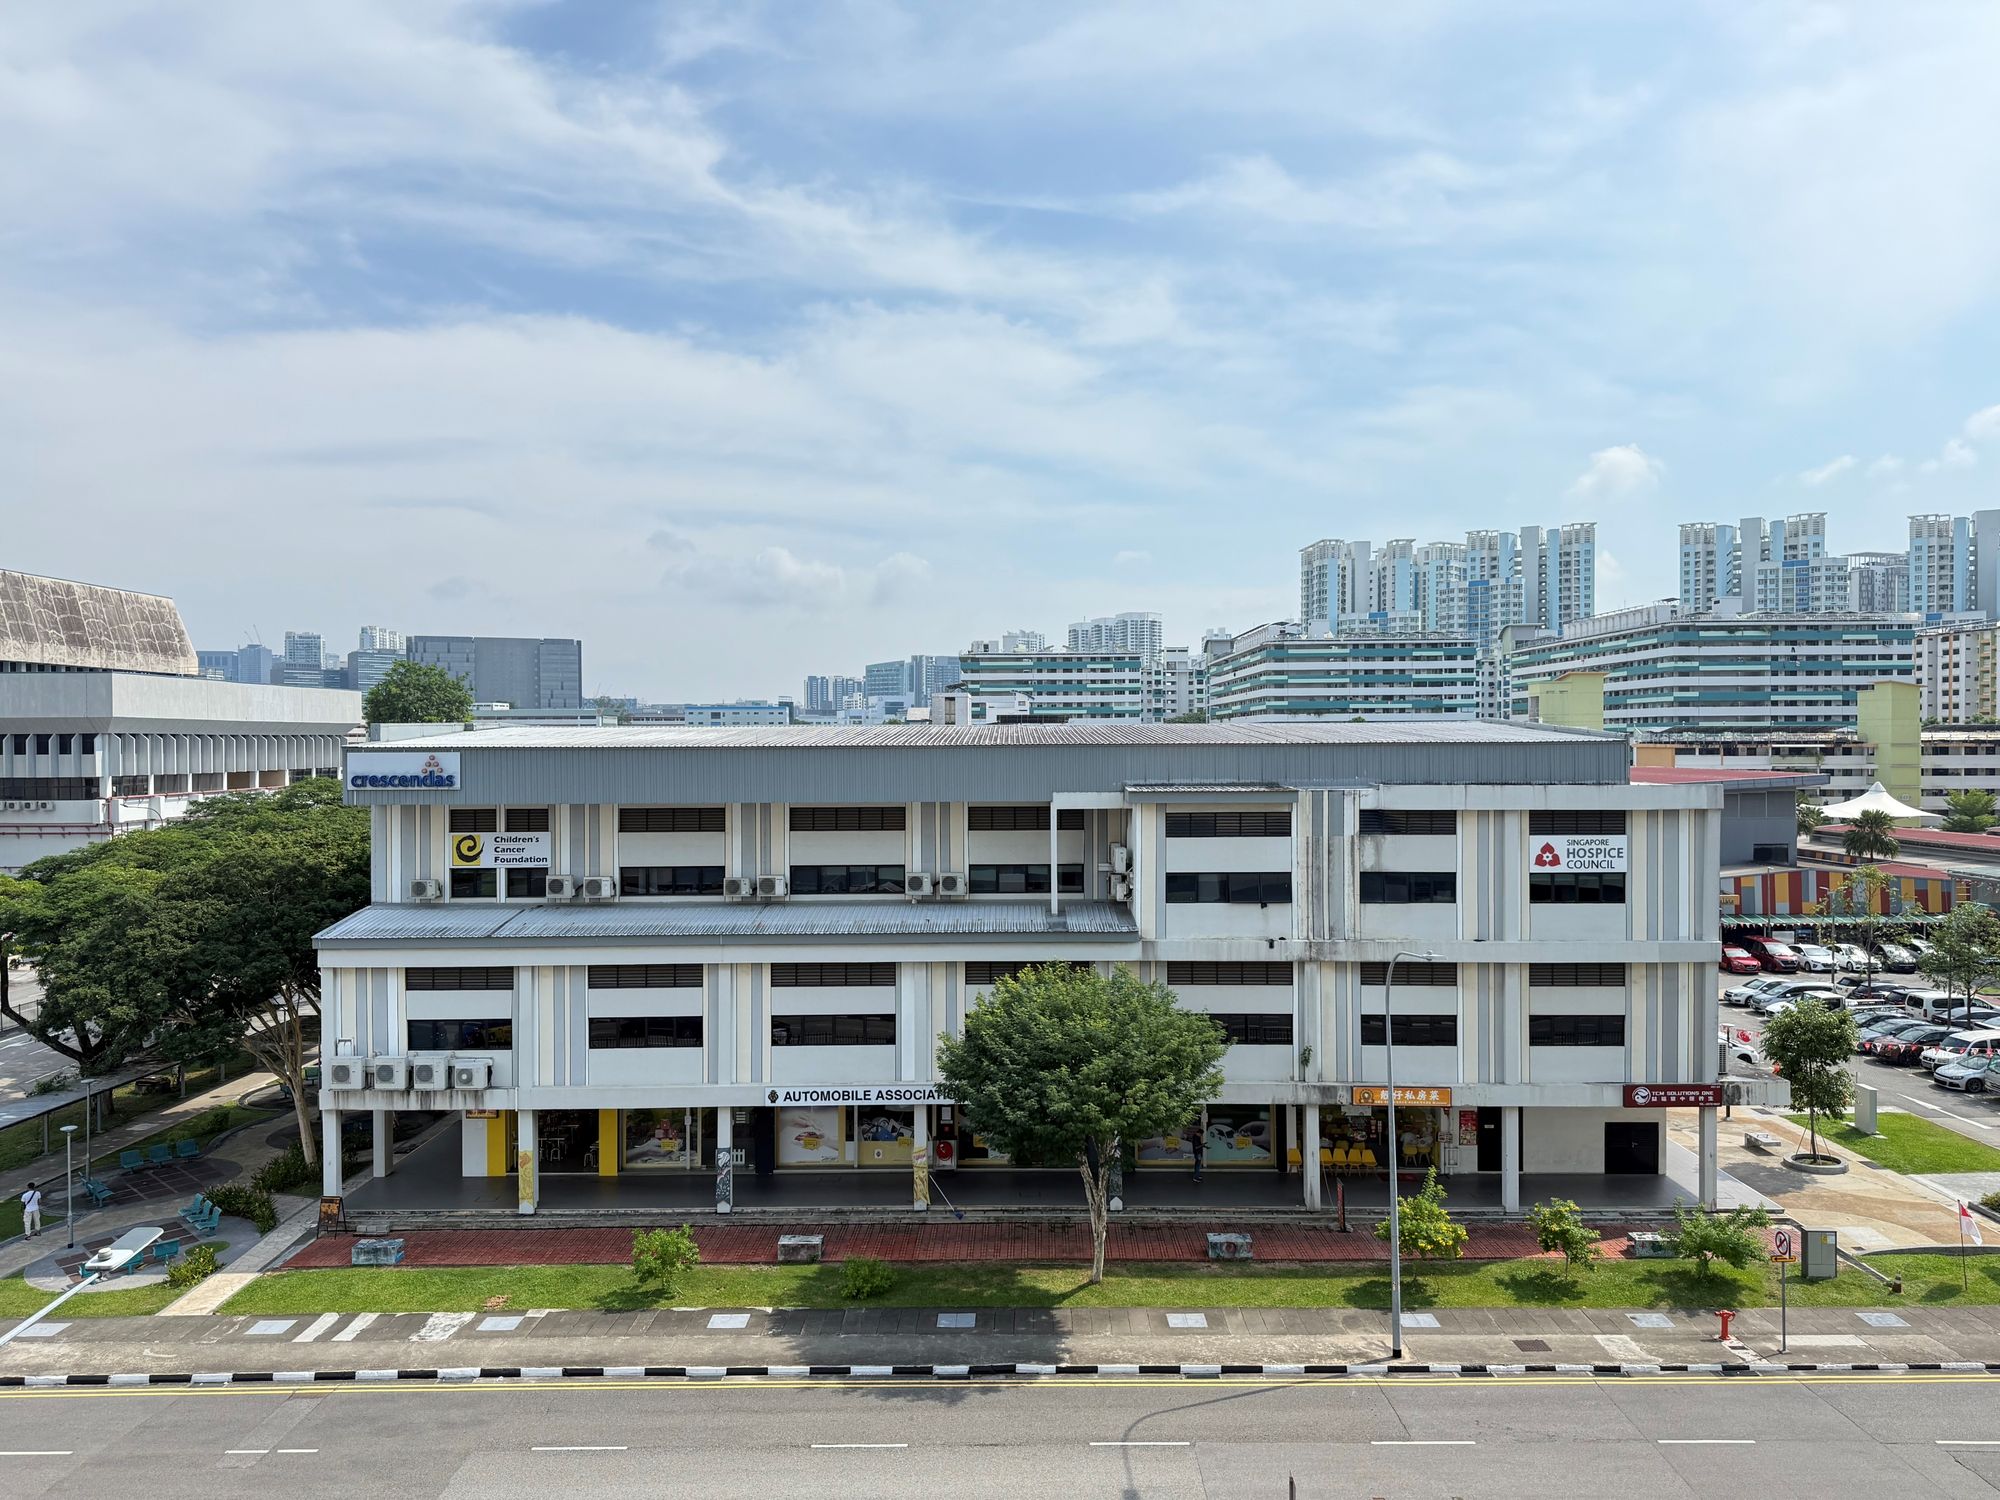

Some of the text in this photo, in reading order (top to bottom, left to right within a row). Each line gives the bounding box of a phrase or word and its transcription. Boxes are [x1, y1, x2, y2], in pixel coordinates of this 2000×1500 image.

[350, 769, 455, 788] crescendas
[493, 835, 540, 844] Children's
[1566, 838, 1610, 846] SINGAPORE
[493, 846, 526, 854] Cancer
[1566, 847, 1624, 859] HOSPICE
[493, 855, 548, 864] Foundation
[1566, 859, 1616, 870] COUNCIL
[783, 1090, 871, 1102] AUTOMOBILE
